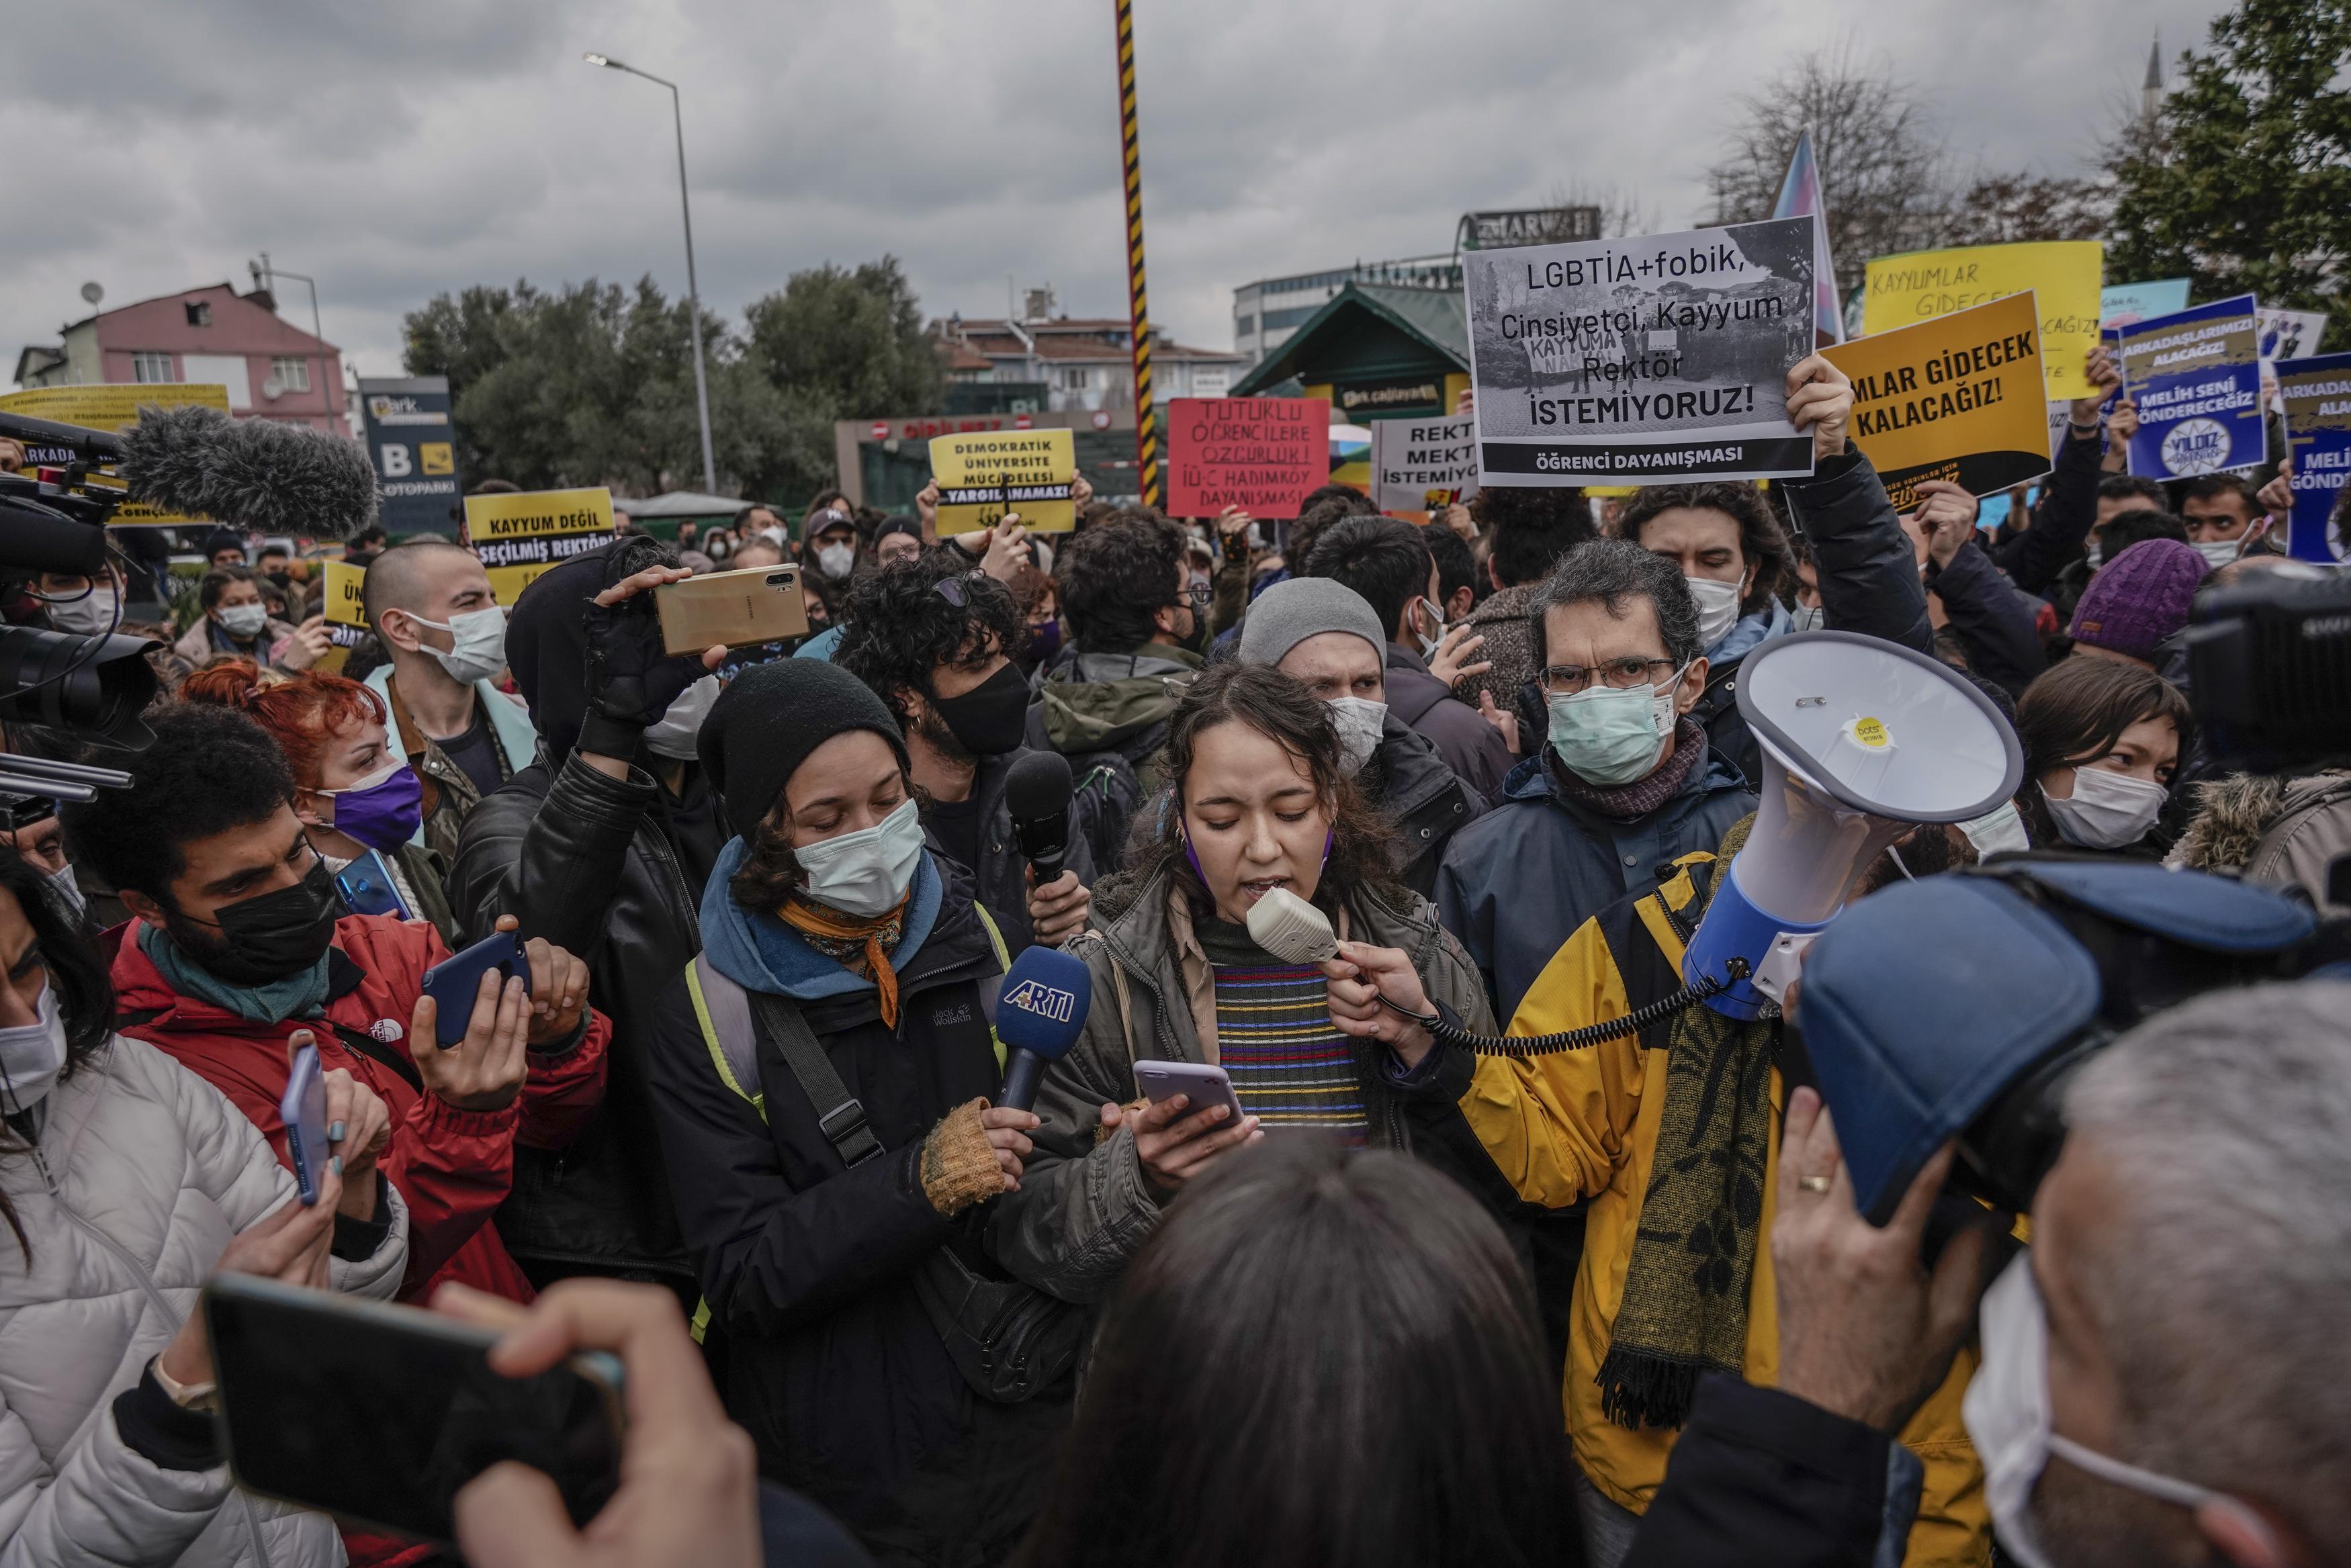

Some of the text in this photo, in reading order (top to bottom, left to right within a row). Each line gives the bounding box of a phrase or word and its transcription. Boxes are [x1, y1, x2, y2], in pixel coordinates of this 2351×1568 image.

[1527, 244, 1744, 289] LGBTİA+fobik,
[1871, 263, 1979, 296] KAYYUMLAR
[1915, 289, 2023, 316] GİDEC
[1501, 295, 1783, 340] Cinsiyetçi, Kayyum
[2041, 315, 2100, 338] CAĞIZ!
[2123, 318, 2254, 358] ARKADAŞLARIMIZI
[2152, 340, 2226, 367] ALACAĞIZ!
[1583, 352, 1684, 383] Rektör
[1851, 330, 2035, 405] MLAR GİDECEK
[2140, 374, 2236, 408] MELİH SENİ
[2282, 380, 2351, 399] ARKADA
[1199, 401, 1302, 420] TUTUKLU
[1529, 385, 1754, 425] İSTEMİYORUZ!
[1855, 377, 2003, 437] KALACAĞIZ!
[2138, 391, 2255, 424] ÖNDERECEĞİZ
[1411, 422, 1474, 443] REKT
[2170, 432, 2218, 452] YILDIZ
[955, 441, 1052, 455] DEMOKRATİK
[1407, 444, 1475, 465] MEKT
[1536, 447, 1743, 470] ÖĞRENCİ DAYANIŞMASI
[2305, 446, 2351, 469] MELİ
[380, 443, 412, 477] B
[965, 455, 1050, 469] ÜNİVERSİTE
[1225, 466, 1311, 486] HADIMKÖY
[1383, 464, 1478, 484] İSTEMİYO
[2289, 470, 2347, 490] GÖND
[386, 479, 455, 497] OTOPARKI
[490, 508, 601, 535] KAYYUM DEĞİL
[478, 537, 549, 566] SEÇİLMİŞ
[345, 579, 363, 602] ÜN
[1857, 725, 1880, 736] bots
[1003, 979, 1075, 1023] ARTI
[932, 1007, 955, 1019] Jack
[934, 1014, 971, 1027] Wolfskin
